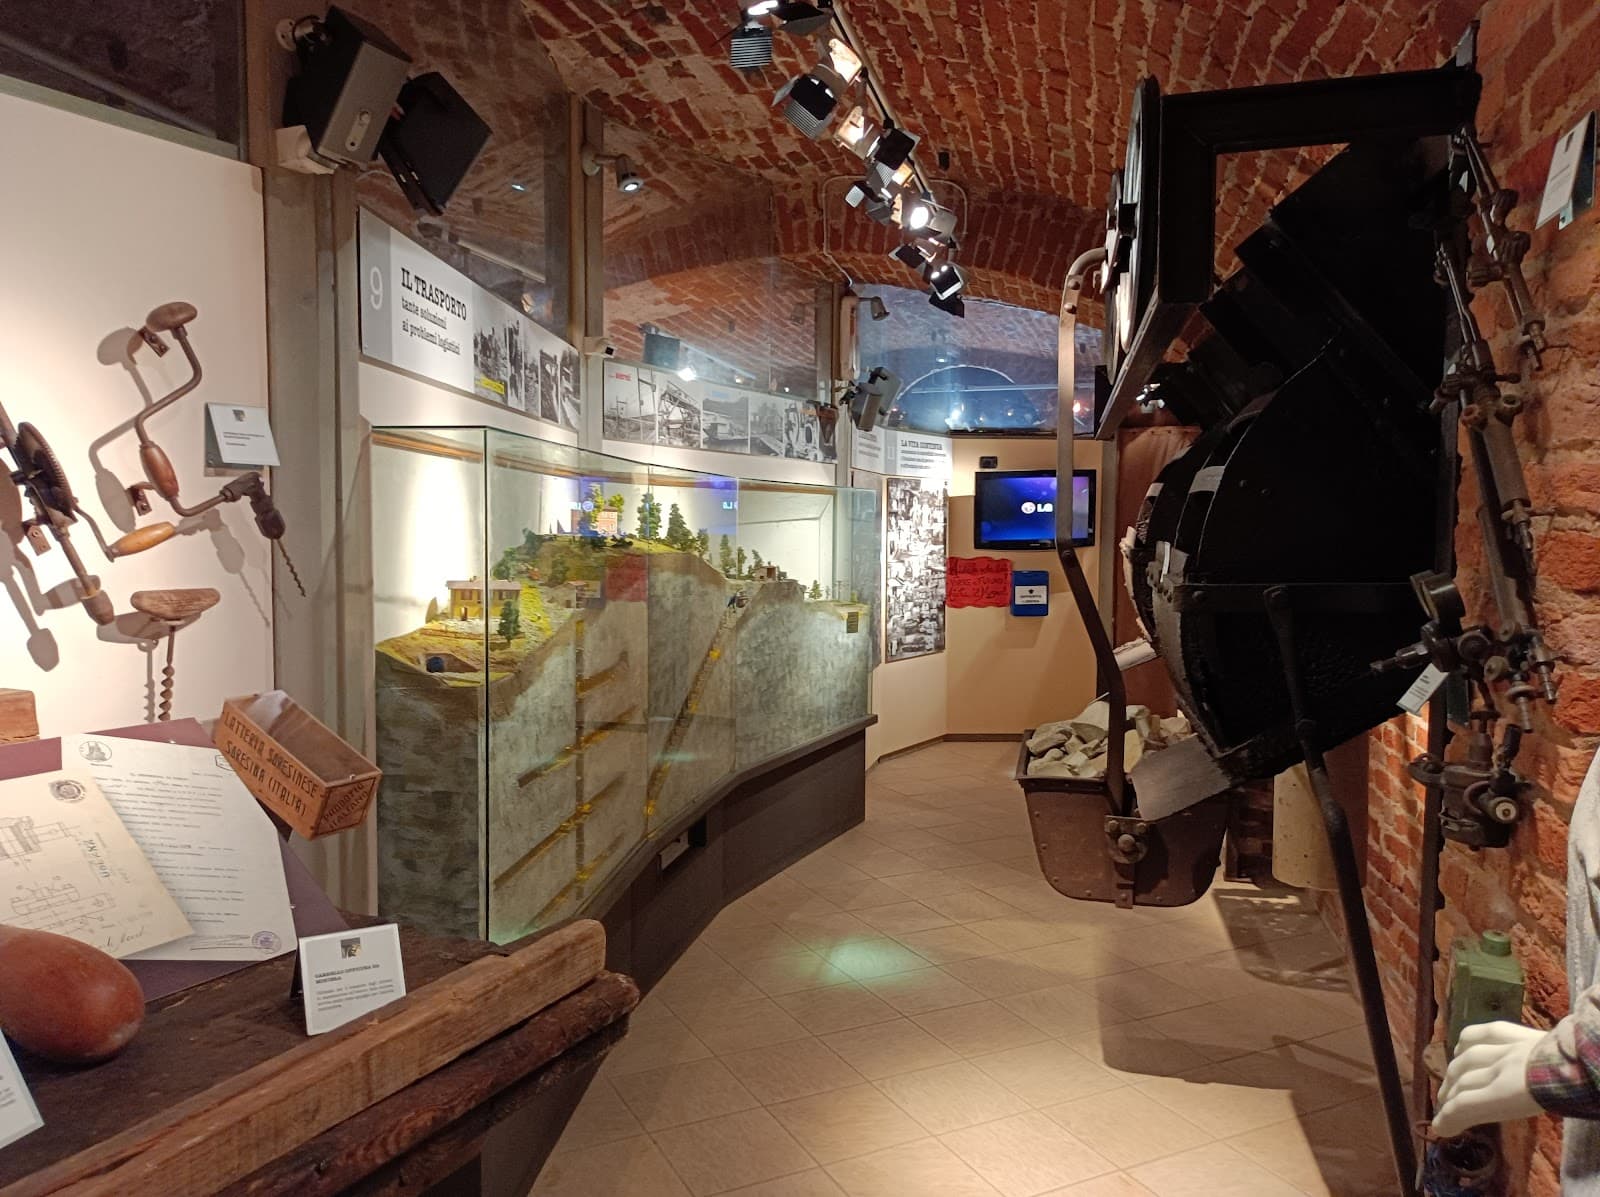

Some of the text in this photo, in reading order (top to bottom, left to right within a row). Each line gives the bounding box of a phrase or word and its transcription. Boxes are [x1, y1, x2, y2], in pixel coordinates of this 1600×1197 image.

[370, 266, 383, 311] 9
[401, 267, 467, 321] IL TRASPORTO
[1037, 503, 1053, 513] LG
[224, 711, 320, 799] LATTERIA SORESINESE
[225, 740, 266, 782] SORESINA
